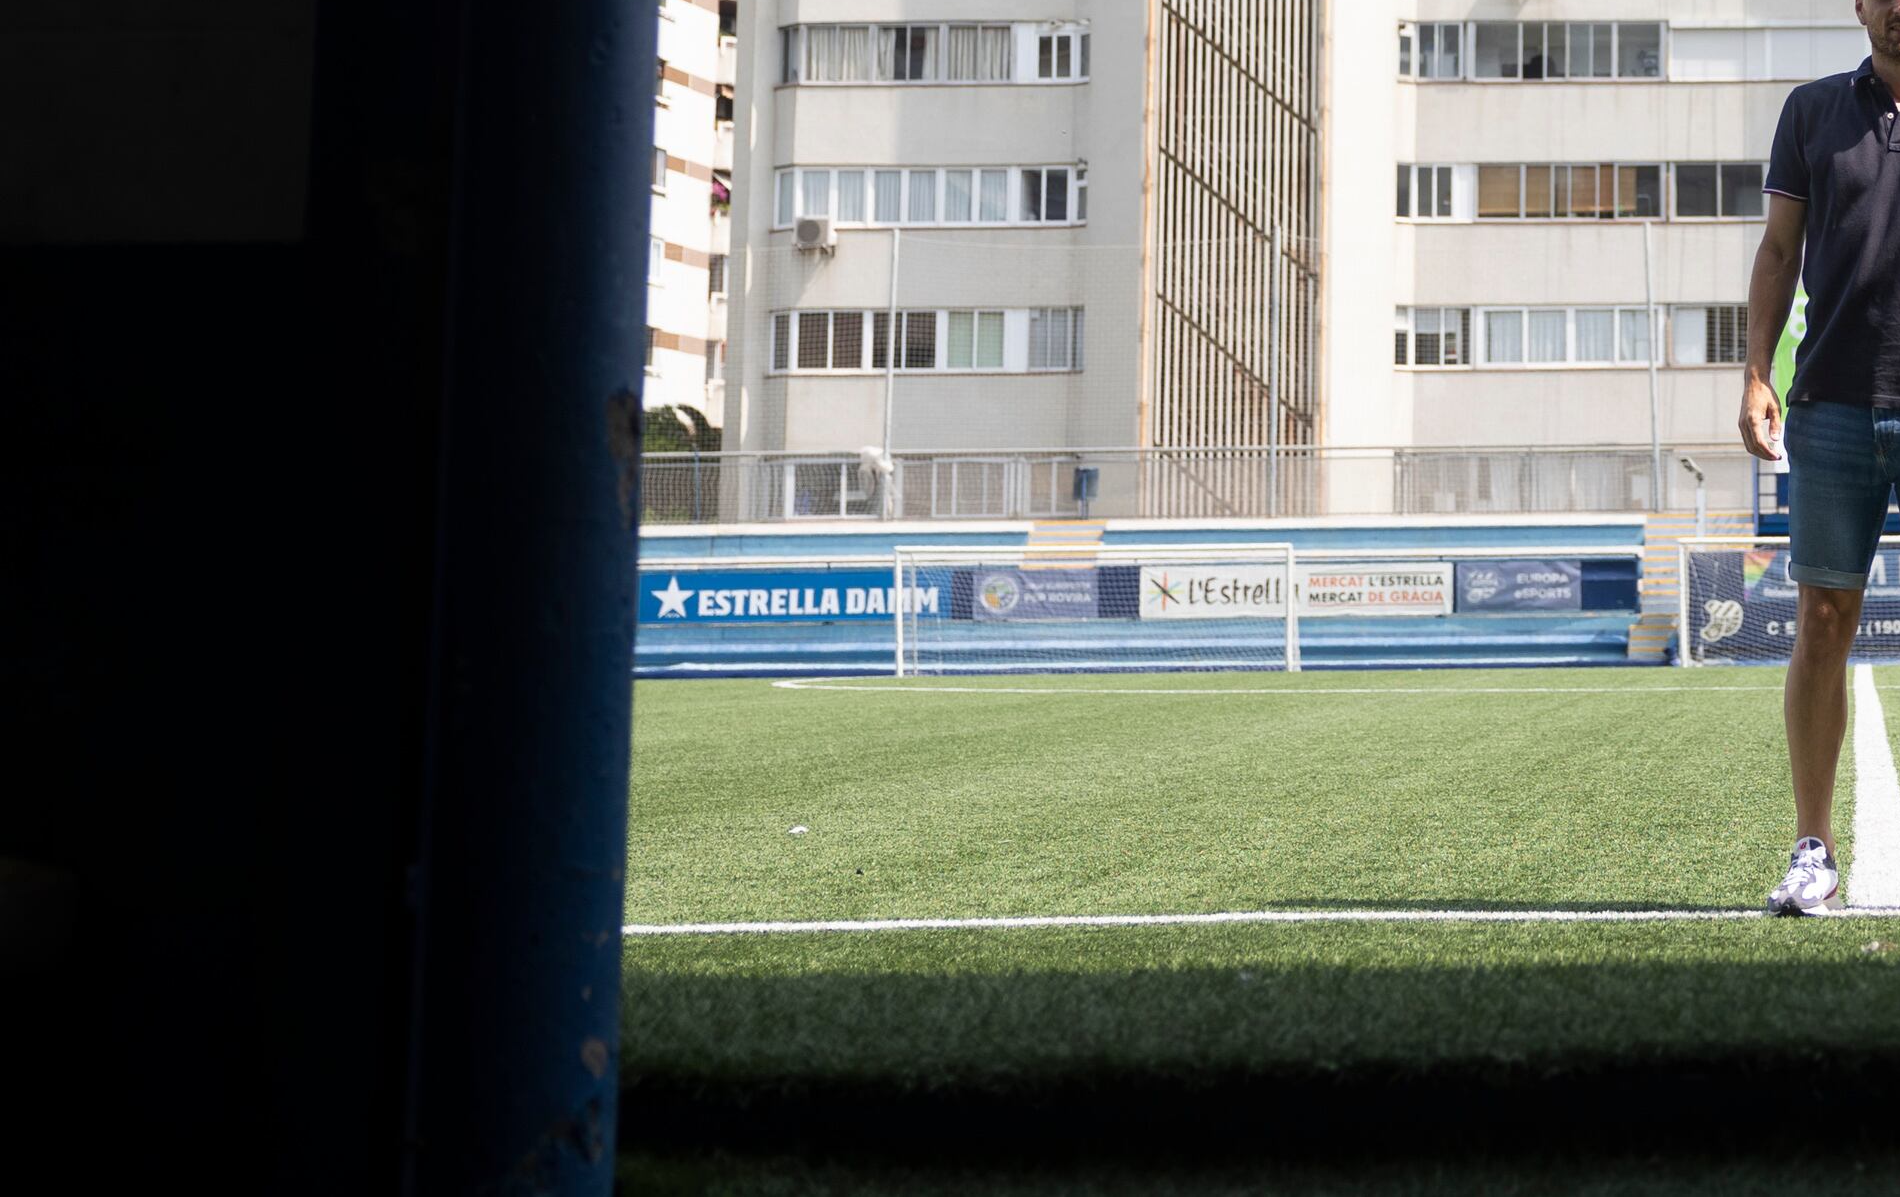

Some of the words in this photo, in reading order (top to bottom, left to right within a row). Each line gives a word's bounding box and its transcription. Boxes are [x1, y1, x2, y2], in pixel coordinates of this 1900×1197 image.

[1308, 576, 1364, 588] MERCAT
[1368, 575, 1444, 587] L'ESTRELLA
[1516, 573, 1570, 585] EUROPA
[698, 587, 841, 616] ESTRELLA
[845, 586, 939, 614] DAMM
[1308, 592, 1363, 603] MERCAT
[1368, 591, 1385, 603] DE
